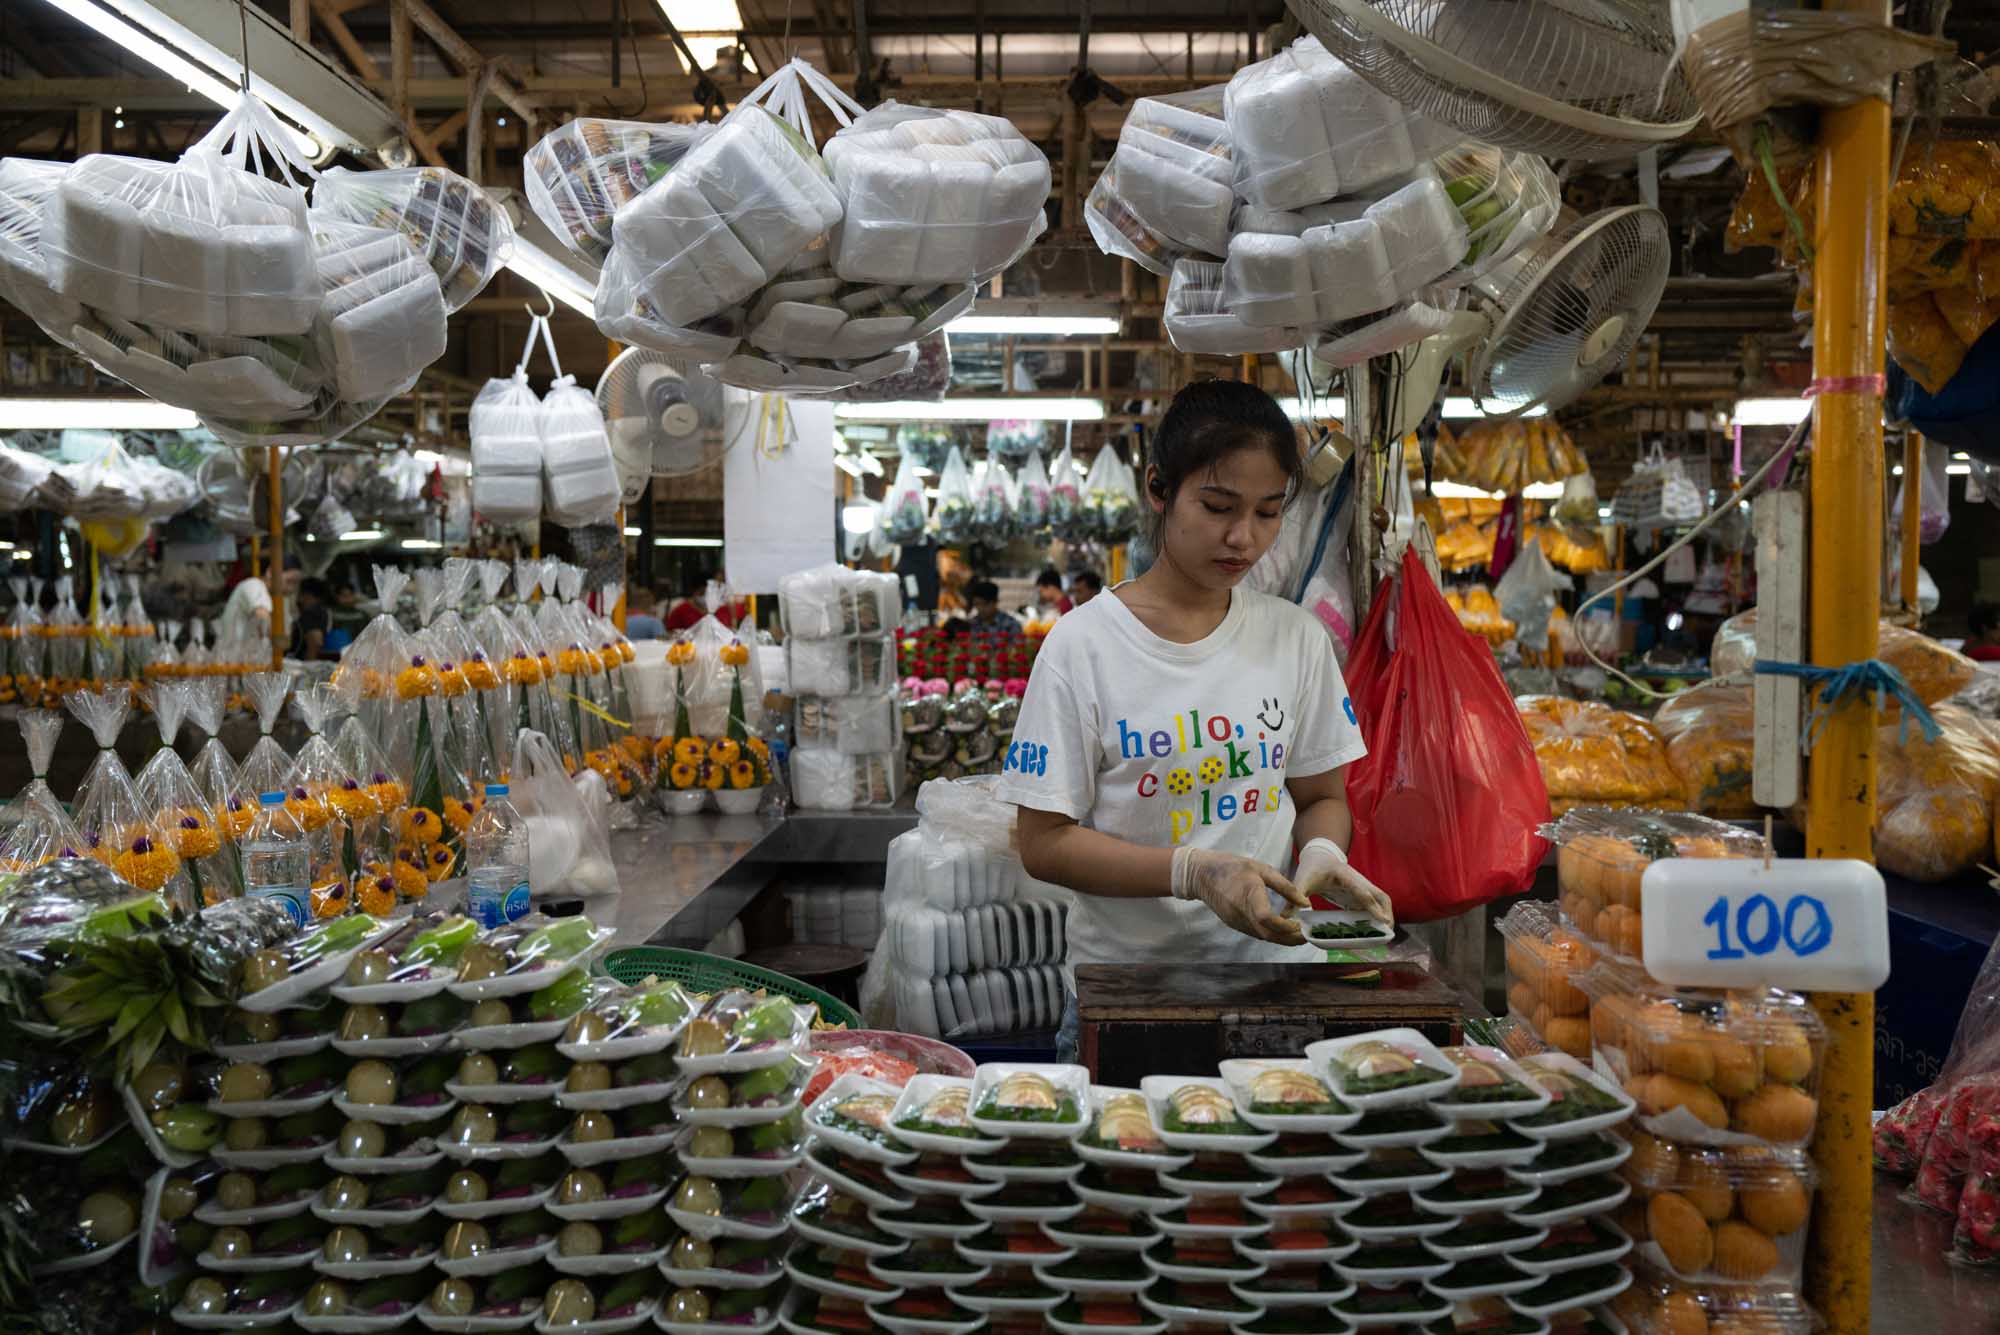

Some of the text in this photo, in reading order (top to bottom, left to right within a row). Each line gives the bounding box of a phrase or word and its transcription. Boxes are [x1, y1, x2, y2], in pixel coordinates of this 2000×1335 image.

[1116, 709, 1244, 759] hello,
[1137, 732, 1287, 798] cookie
[1169, 785, 1282, 844] pleas
[1704, 894, 1833, 959] 100
